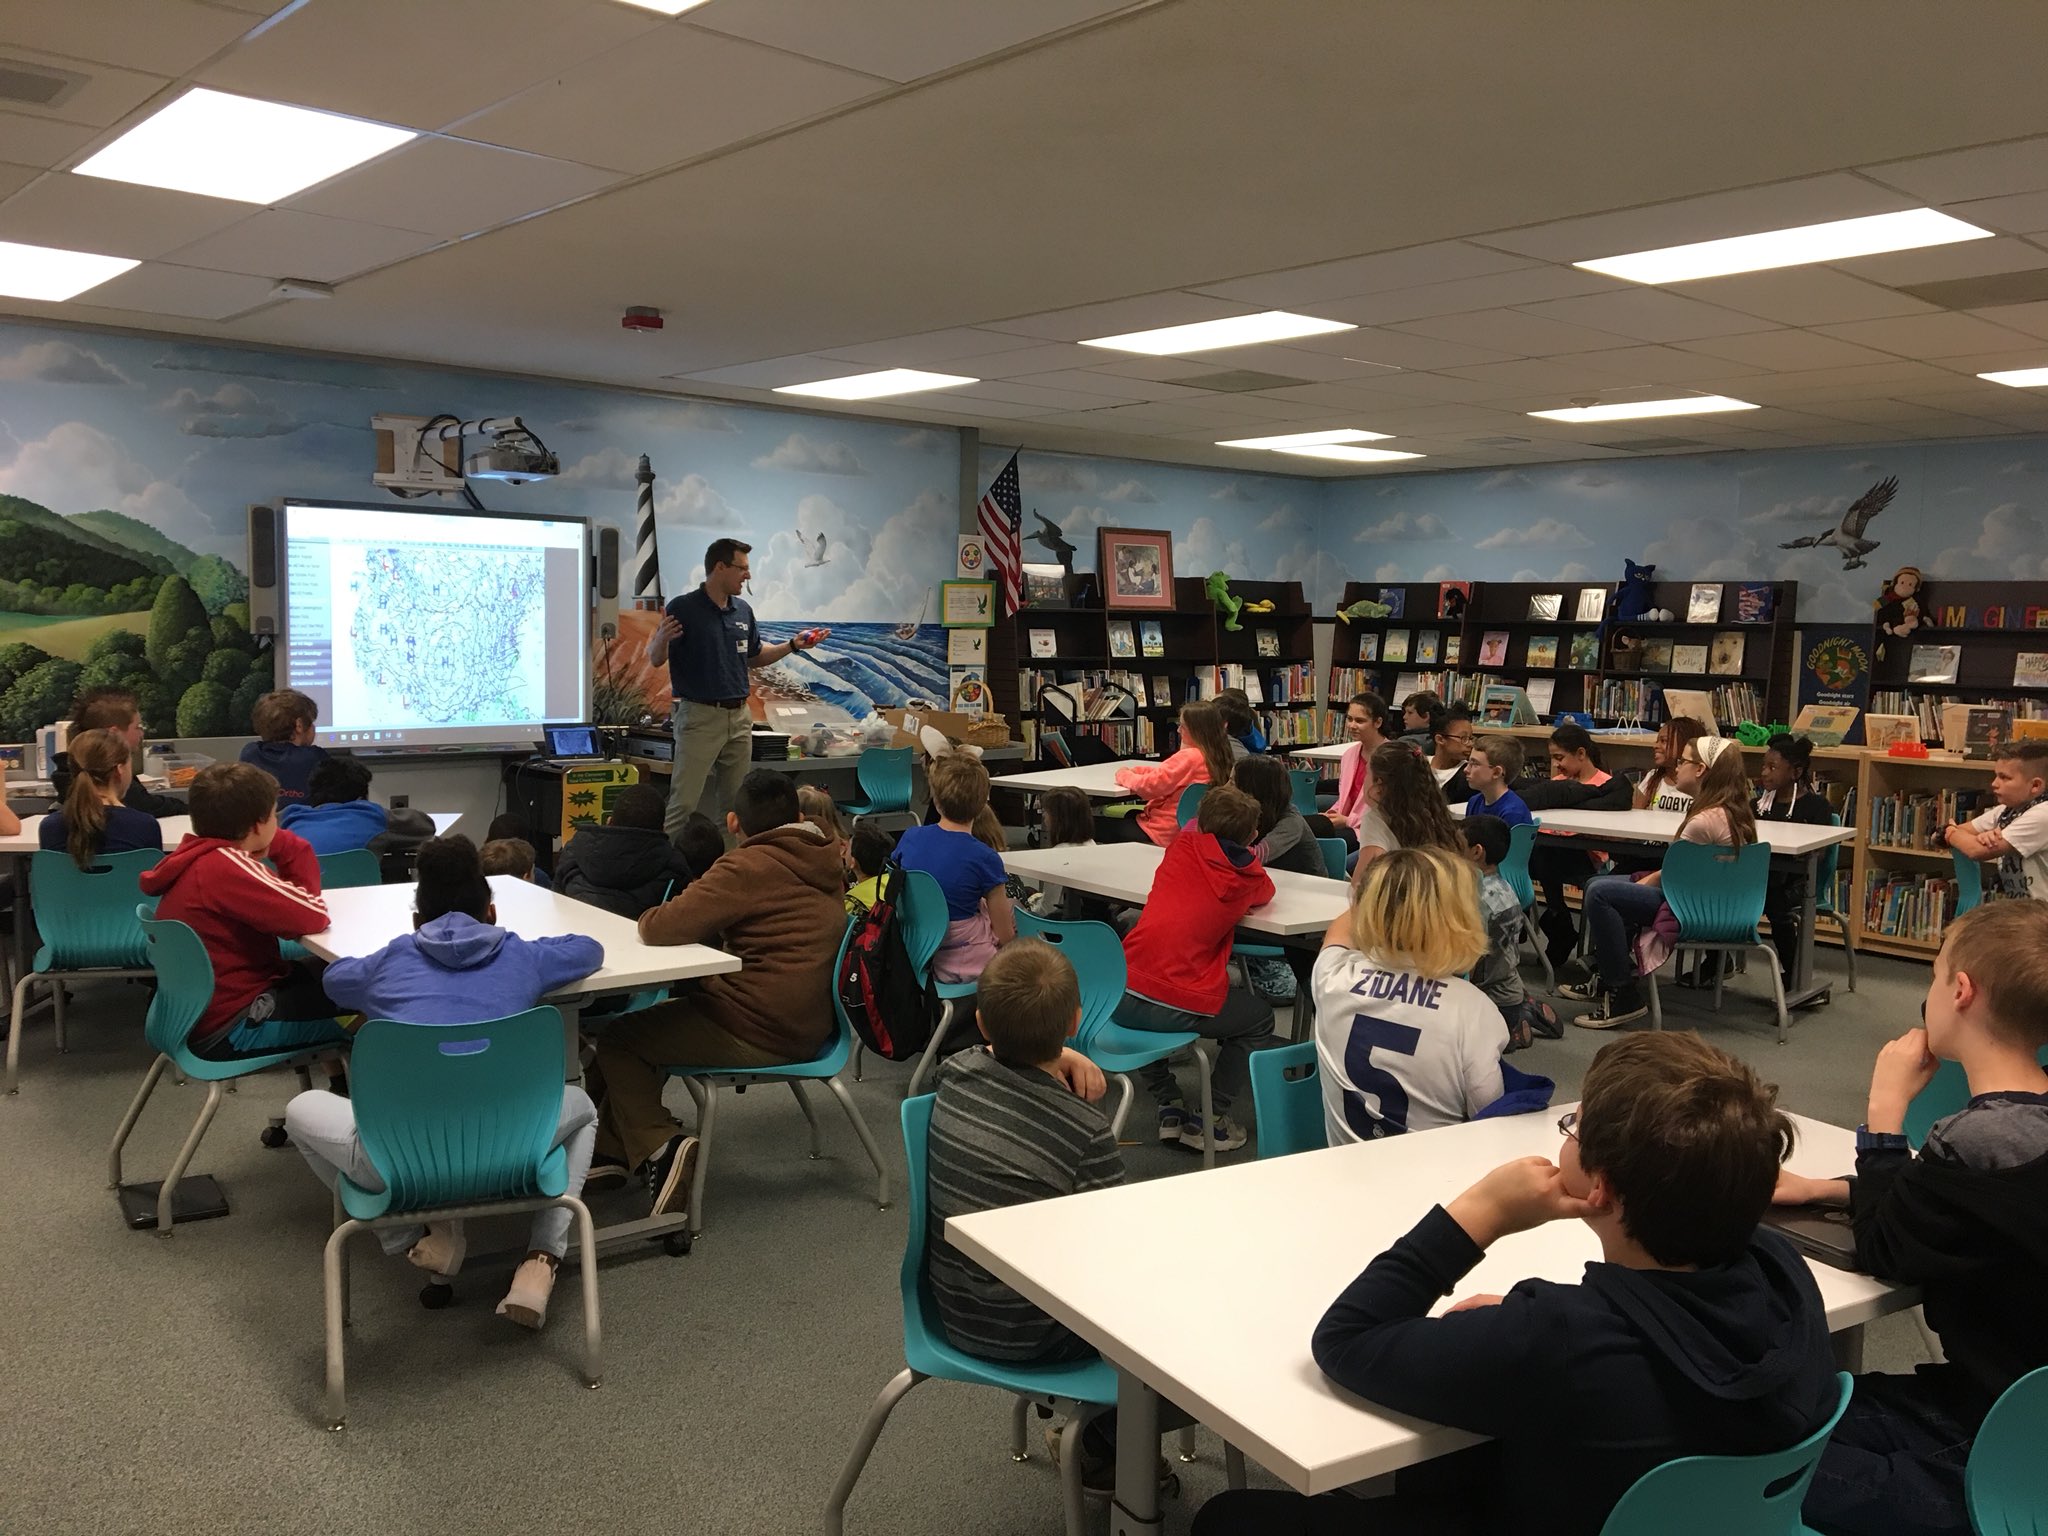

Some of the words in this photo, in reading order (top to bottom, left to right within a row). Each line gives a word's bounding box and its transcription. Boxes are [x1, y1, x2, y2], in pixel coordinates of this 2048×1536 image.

[432, 584, 441, 597] H
[1937, 605, 2041, 628] IMAGINE
[1807, 636, 1855, 670] GOODNIGHT
[1851, 645, 1869, 672] MOON
[277, 788, 305, 798] Ortho
[849, 972, 858, 982] 5
[1343, 1013, 1422, 1141] 5
